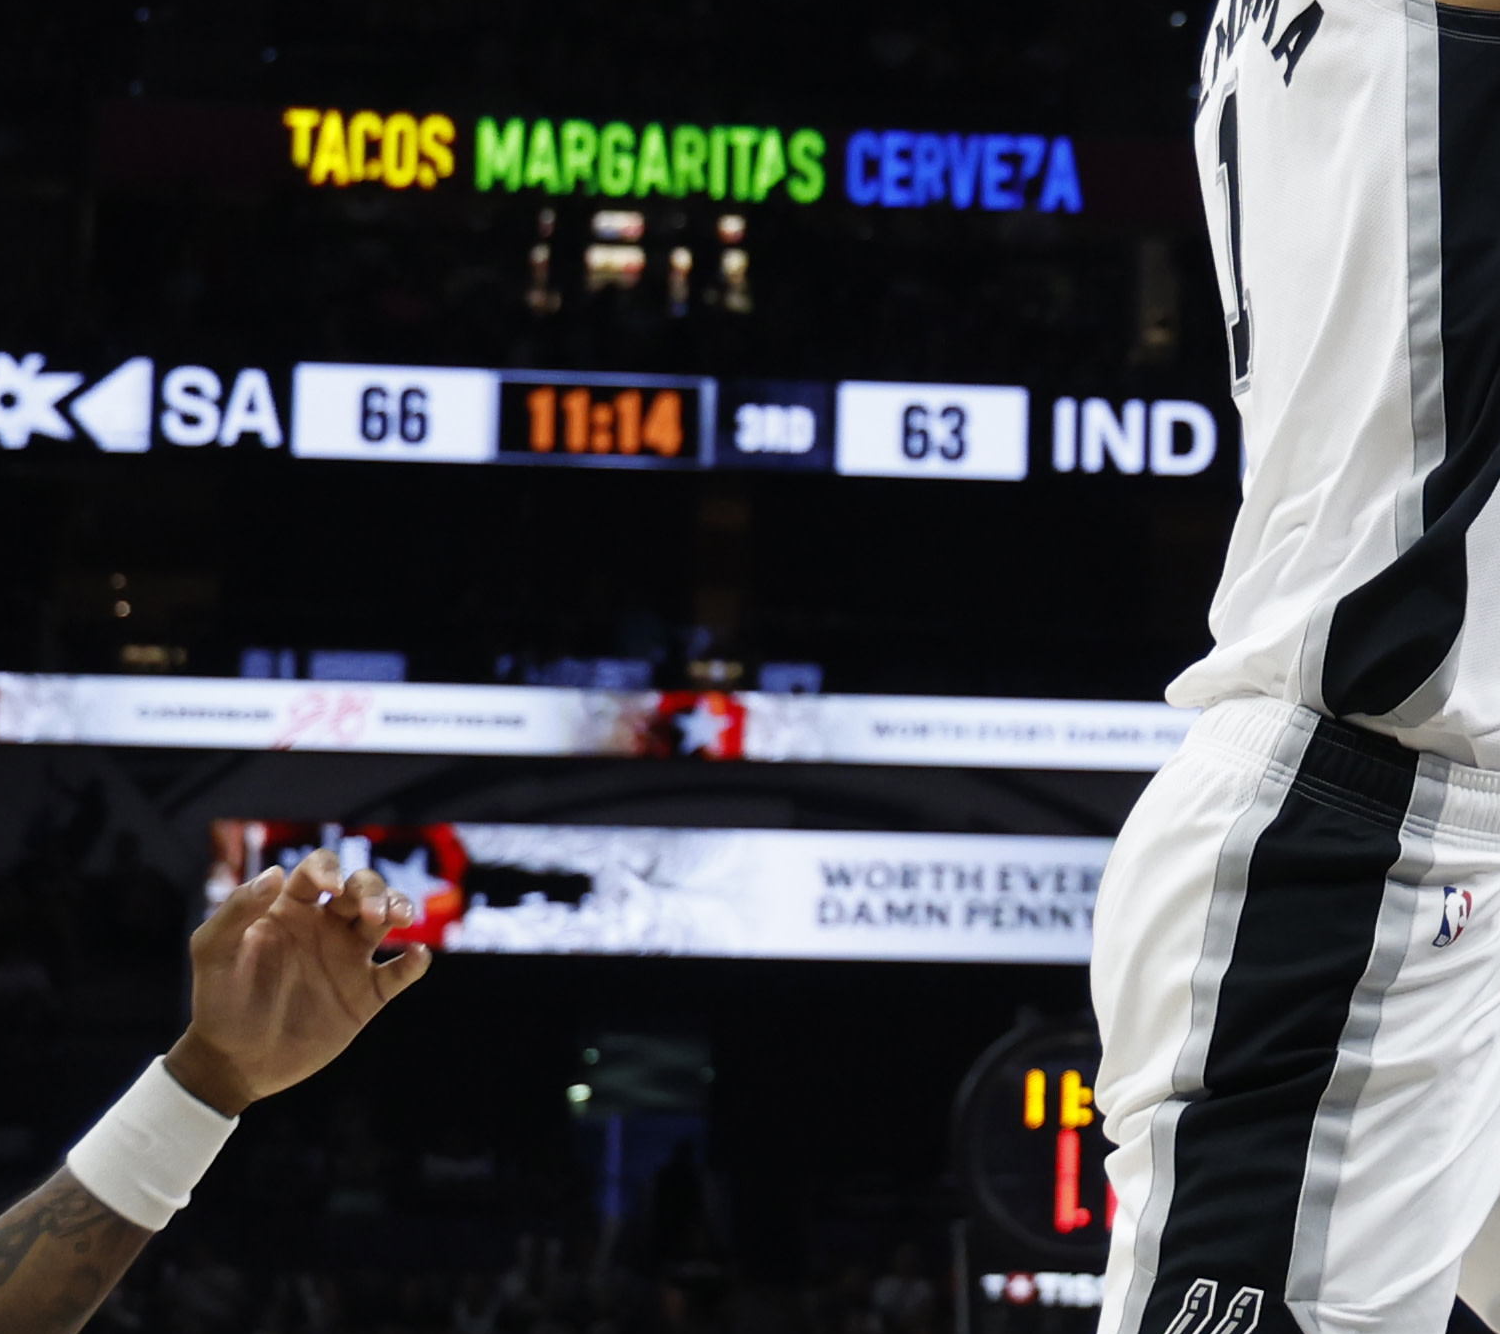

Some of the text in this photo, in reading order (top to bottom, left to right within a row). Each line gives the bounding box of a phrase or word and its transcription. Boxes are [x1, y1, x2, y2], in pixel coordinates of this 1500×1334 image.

[286, 108, 456, 190] TACOS
[473, 116, 827, 203] MARGARITAS
[161, 364, 283, 448] SA
[358, 386, 430, 444] 66
[527, 384, 684, 458] 11:14
[901, 404, 969, 463] 63
[1052, 396, 1218, 477] IND
[819, 863, 984, 893] WORTH
[818, 898, 950, 927] DAMN
